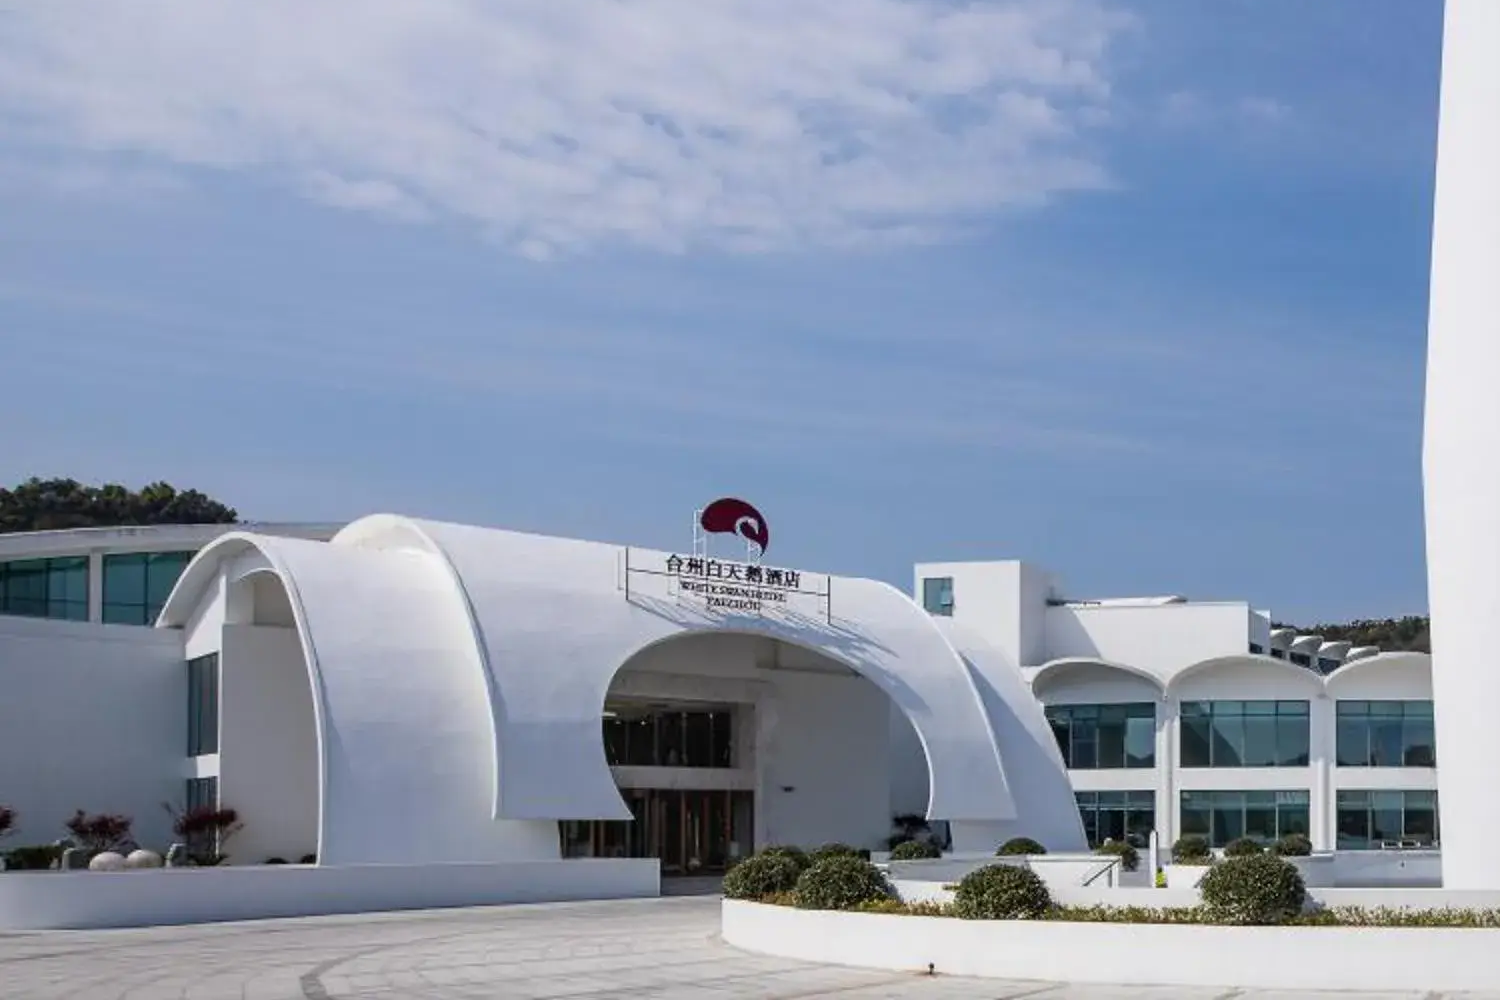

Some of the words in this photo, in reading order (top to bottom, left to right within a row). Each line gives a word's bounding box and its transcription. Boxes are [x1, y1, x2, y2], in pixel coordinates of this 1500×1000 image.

[666, 554, 800, 588] 台州白天鹅酒店
[680, 581, 719, 594] WHITE
